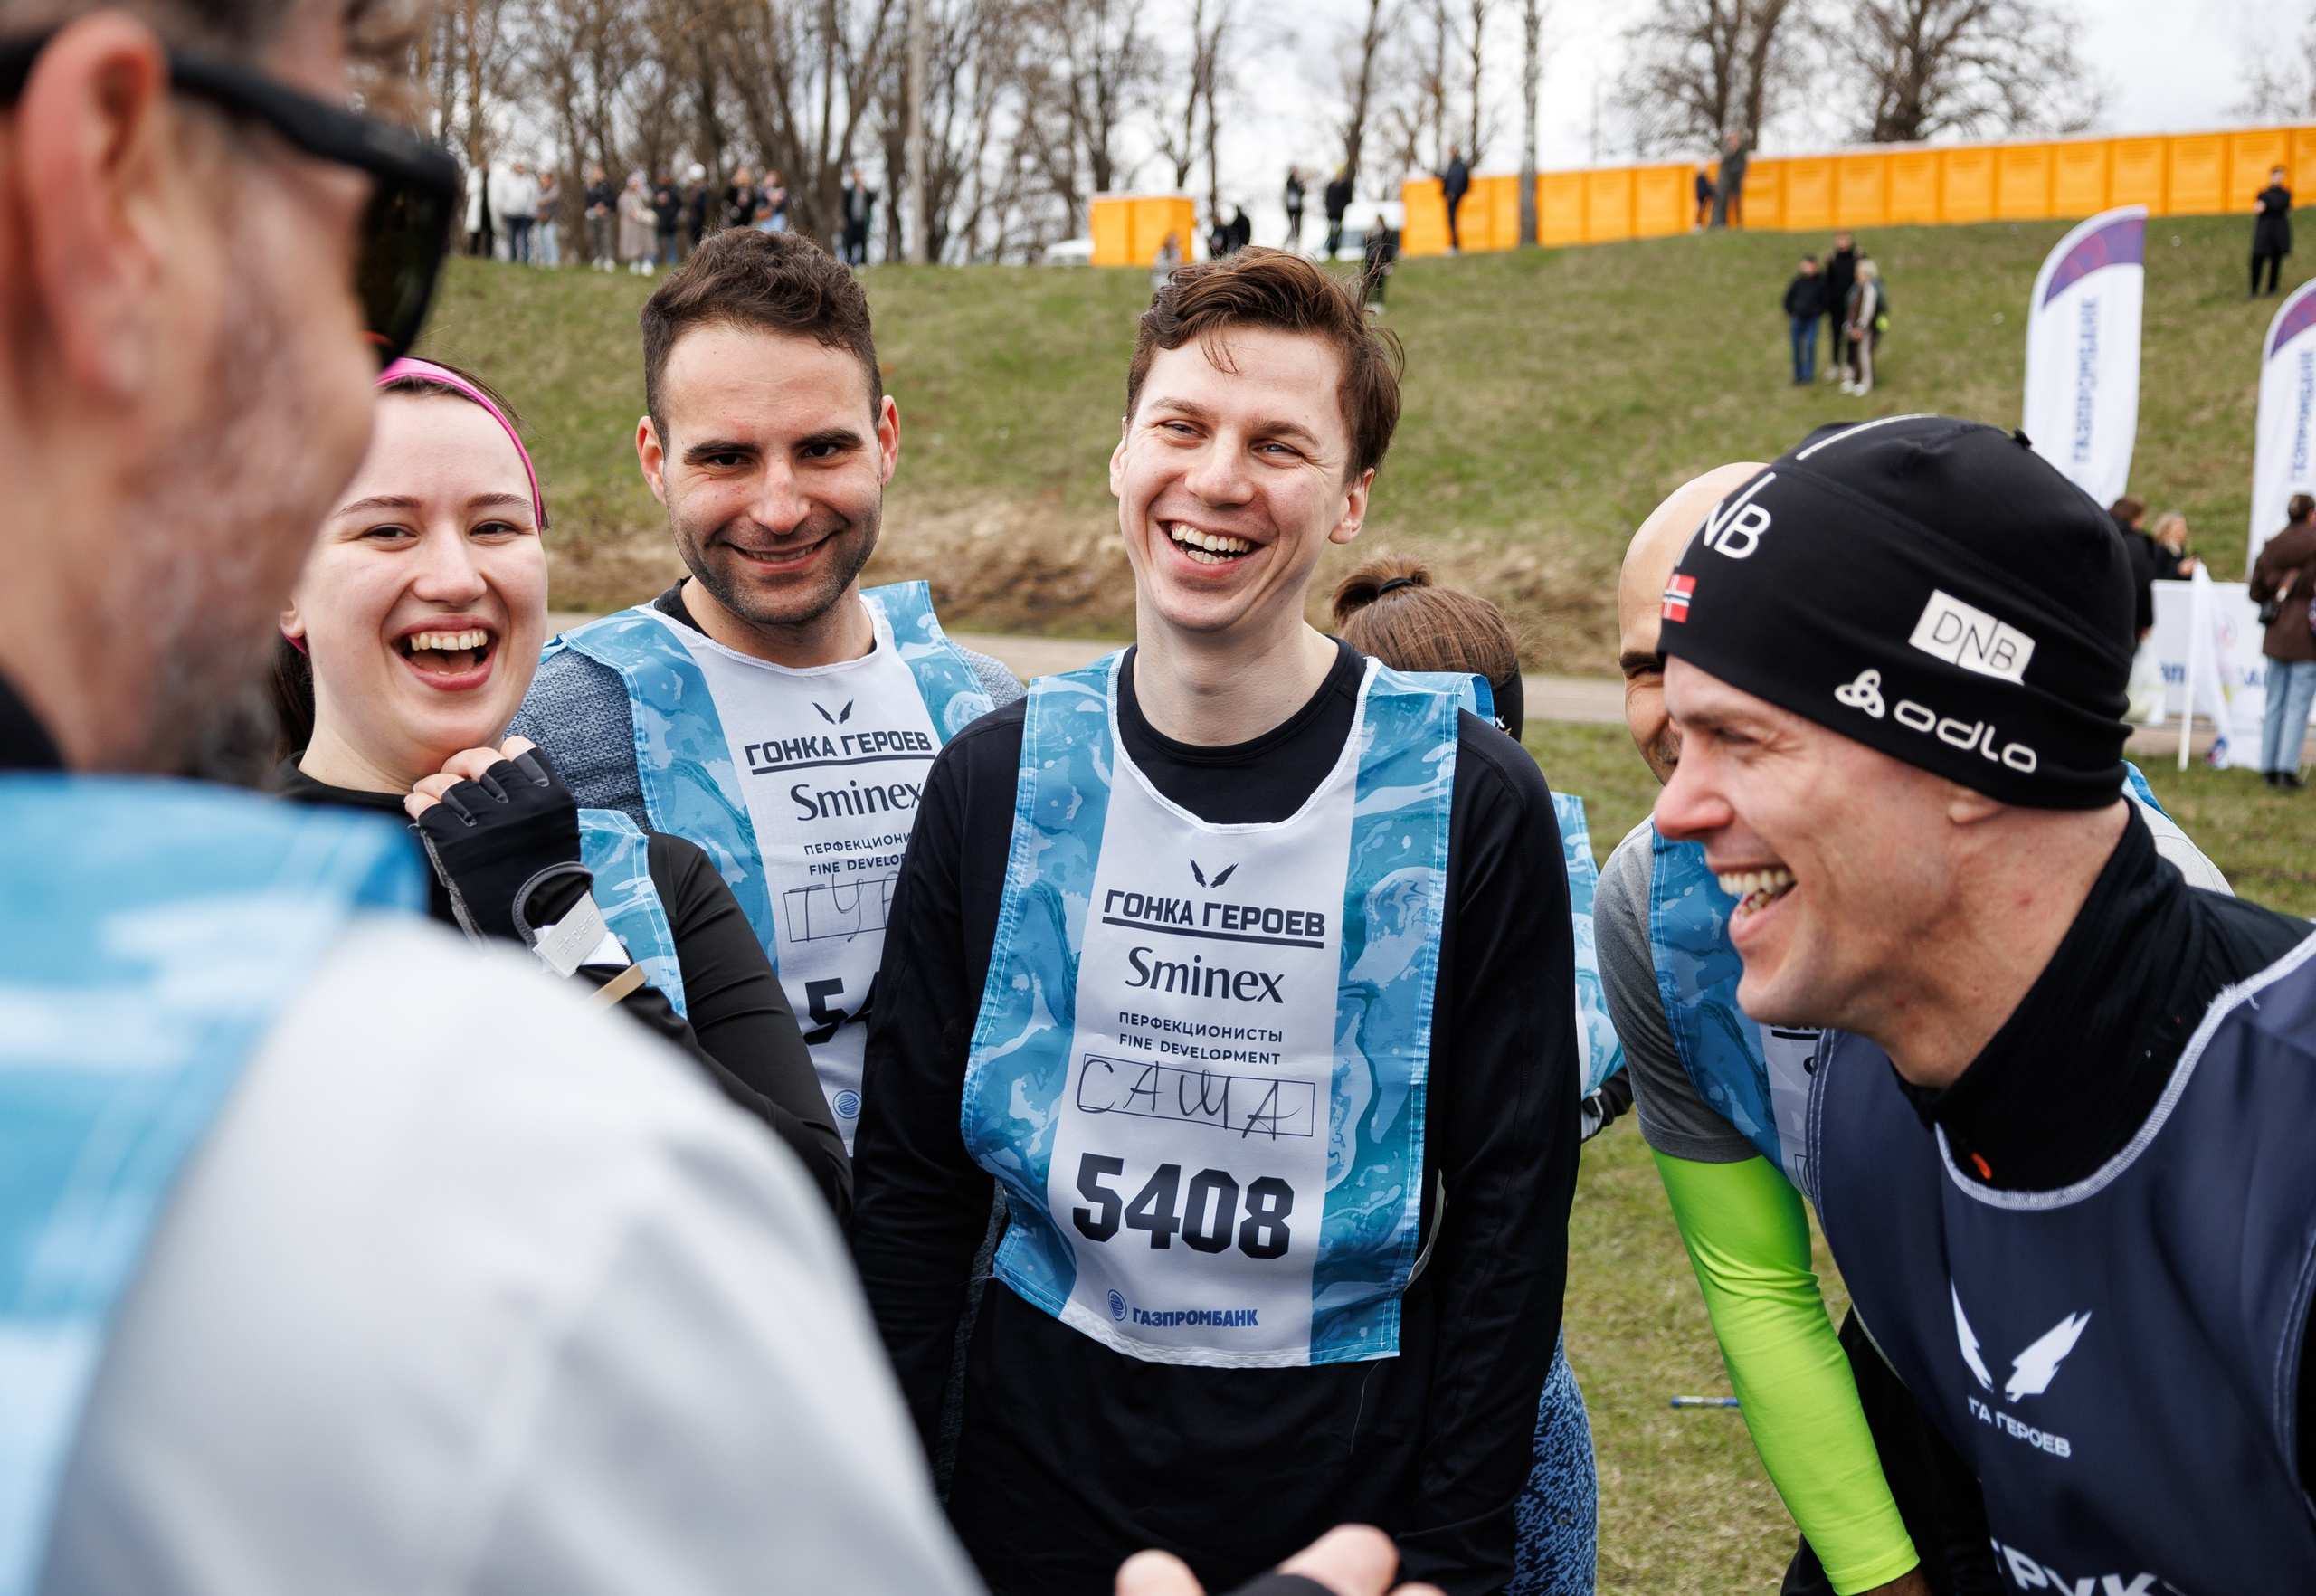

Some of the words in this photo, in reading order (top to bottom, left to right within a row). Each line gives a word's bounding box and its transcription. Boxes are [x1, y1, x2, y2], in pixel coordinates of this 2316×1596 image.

[1703, 484, 1771, 559] NB
[1931, 609, 2018, 672] DNB
[744, 735, 838, 767] ГОНКА
[842, 730, 933, 756] ГЕРОЕВ
[1893, 698, 2037, 774] odlo
[790, 779, 921, 822] Sminex
[804, 832, 911, 855] ПЕРФЕКЦИОНИ
[809, 861, 840, 876] FINE
[847, 853, 905, 870] DEVELO
[1103, 889, 1193, 926] ГОНКА
[1203, 903, 1325, 938] ГЕРОЕВ
[1125, 946, 1284, 1004] Sminex
[803, 971, 879, 1046] 54
[1119, 1012, 1283, 1043] ПЕРФЕКЦИОНИСТЫ
[1119, 1033, 1153, 1051] FINE
[1160, 1040, 1281, 1066] DEVELOPMENT
[1072, 1152, 1295, 1260] 5408
[1132, 1306, 1258, 1328] ГАЗПРОМБАНК
[1967, 1394, 1992, 1425] ГА
[1995, 1411, 2072, 1458] ГЕРОЕВ
